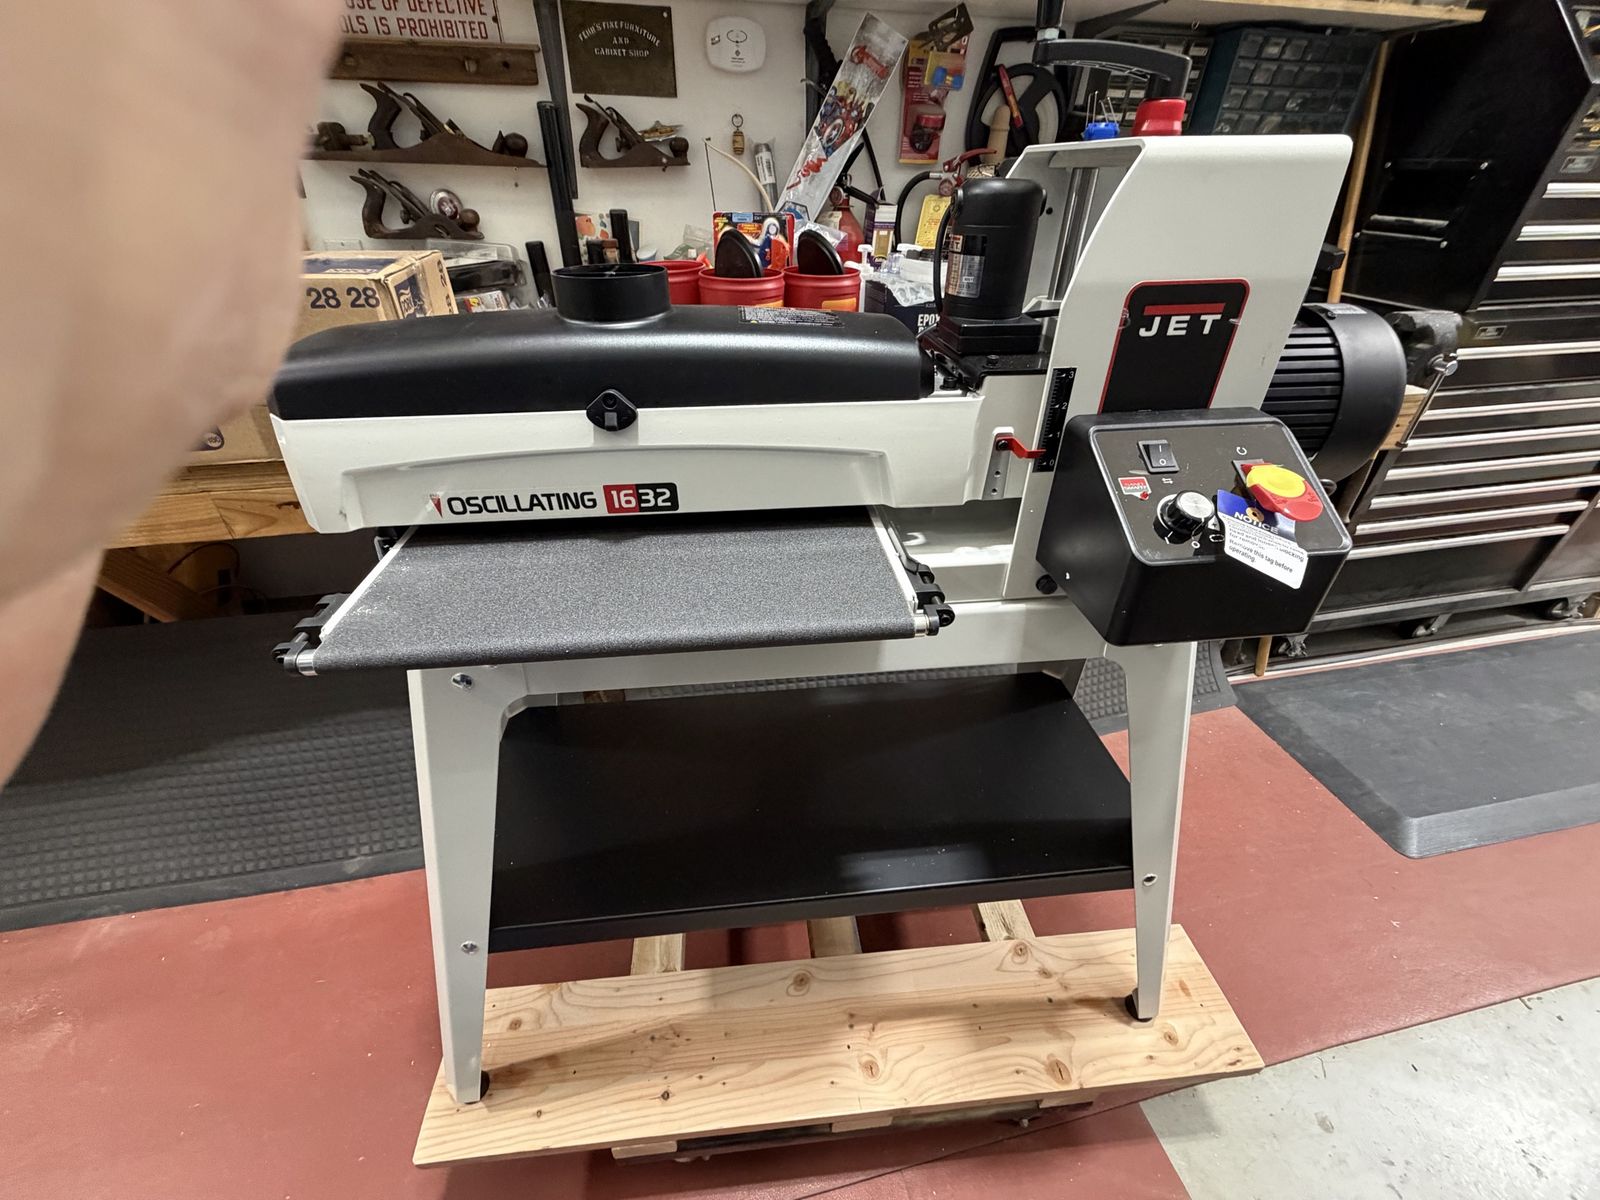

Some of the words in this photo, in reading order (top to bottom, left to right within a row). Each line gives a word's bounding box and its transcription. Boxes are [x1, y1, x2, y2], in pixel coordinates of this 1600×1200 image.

[382, 0, 398, 11] OF
[408, 0, 488, 15] DEFECTIVE
[338, 15, 369, 34] OLS
[374, 16, 391, 35] IS
[396, 17, 488, 40] PROHIBITED
[602, 21, 618, 30] FINE
[620, 21, 661, 47] FURNITURE
[612, 36, 630, 45] AND
[594, 47, 626, 56] CABINET
[628, 49, 650, 57] SHOP
[306, 287, 341, 309] 28
[346, 287, 381, 308] 28
[917, 313, 940, 327] EPOX
[1138, 314, 1222, 337] JET
[1068, 371, 1075, 379] 3
[1061, 402, 1068, 410] 2
[447, 491, 598, 515] OSCILLATING
[609, 488, 672, 509] 1632
[1233, 512, 1280, 535] NOTICE
[1228, 545, 1256, 563] operating.
[1254, 549, 1265, 559] this
[1265, 555, 1275, 565] tag
[1275, 560, 1293, 573] before
